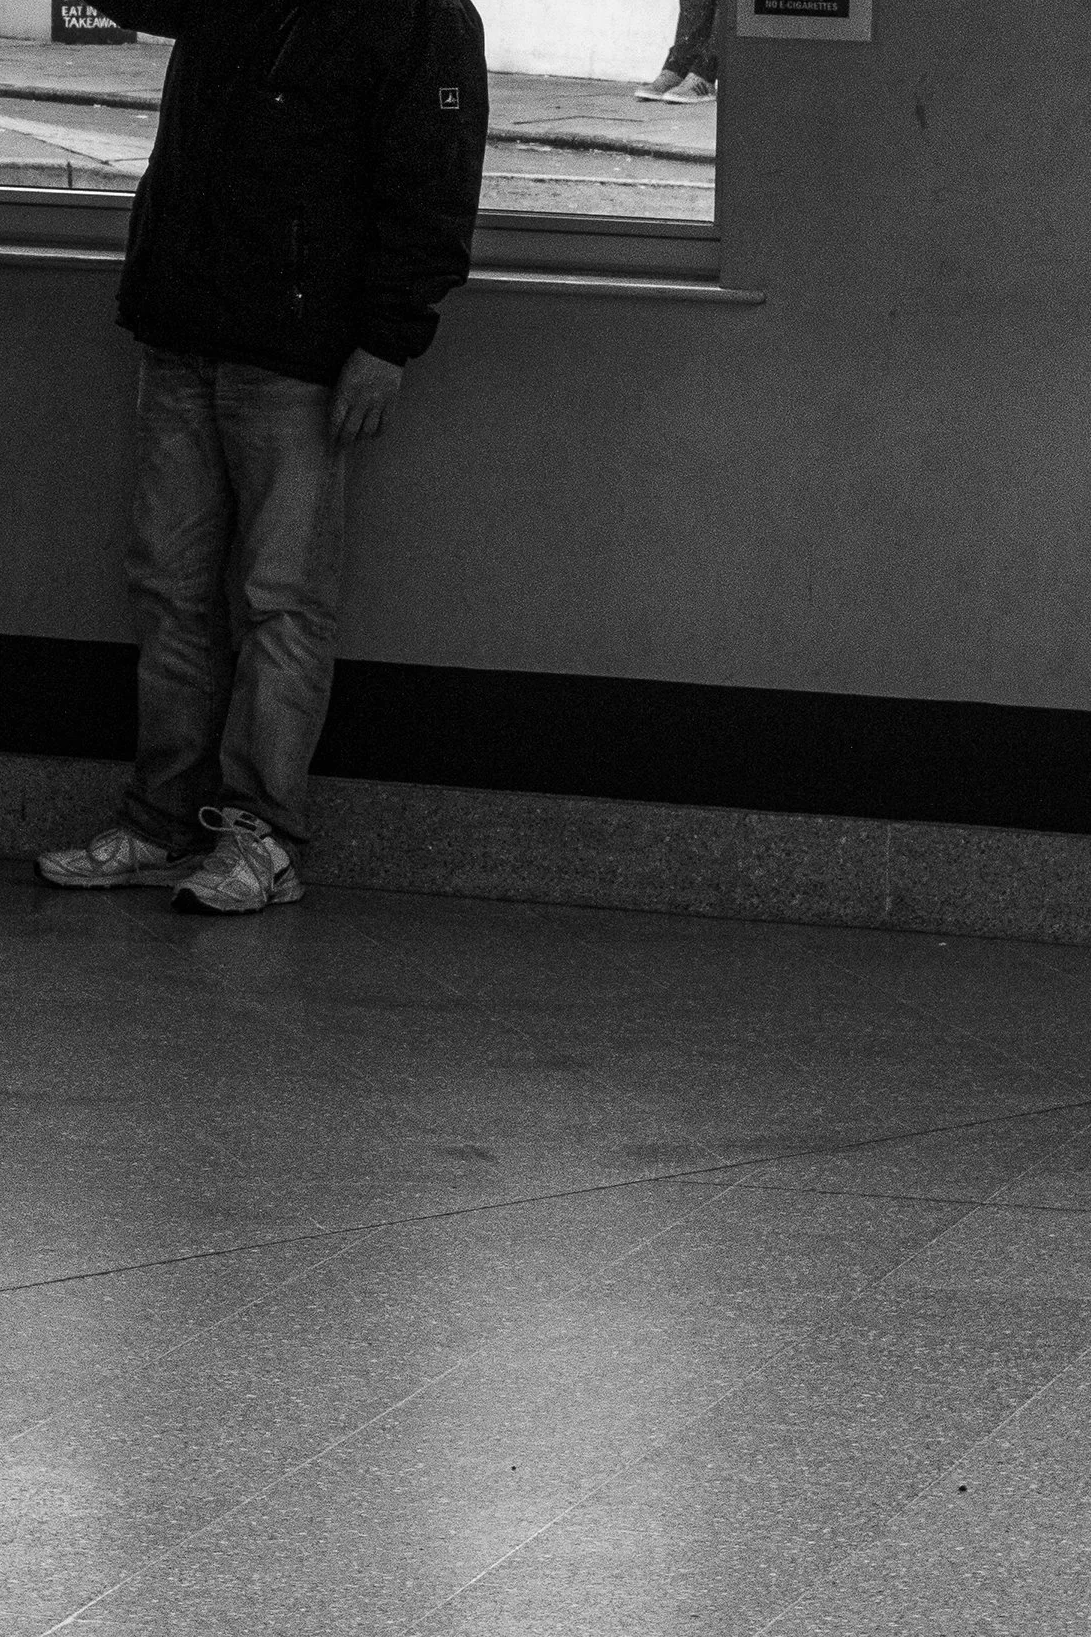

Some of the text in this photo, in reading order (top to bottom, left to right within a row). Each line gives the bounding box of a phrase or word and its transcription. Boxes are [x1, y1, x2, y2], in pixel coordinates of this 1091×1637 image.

[765, 0, 778, 9] NO
[62, 5, 98, 17] EAT IN
[63, 16, 121, 29] TAKEAWA
